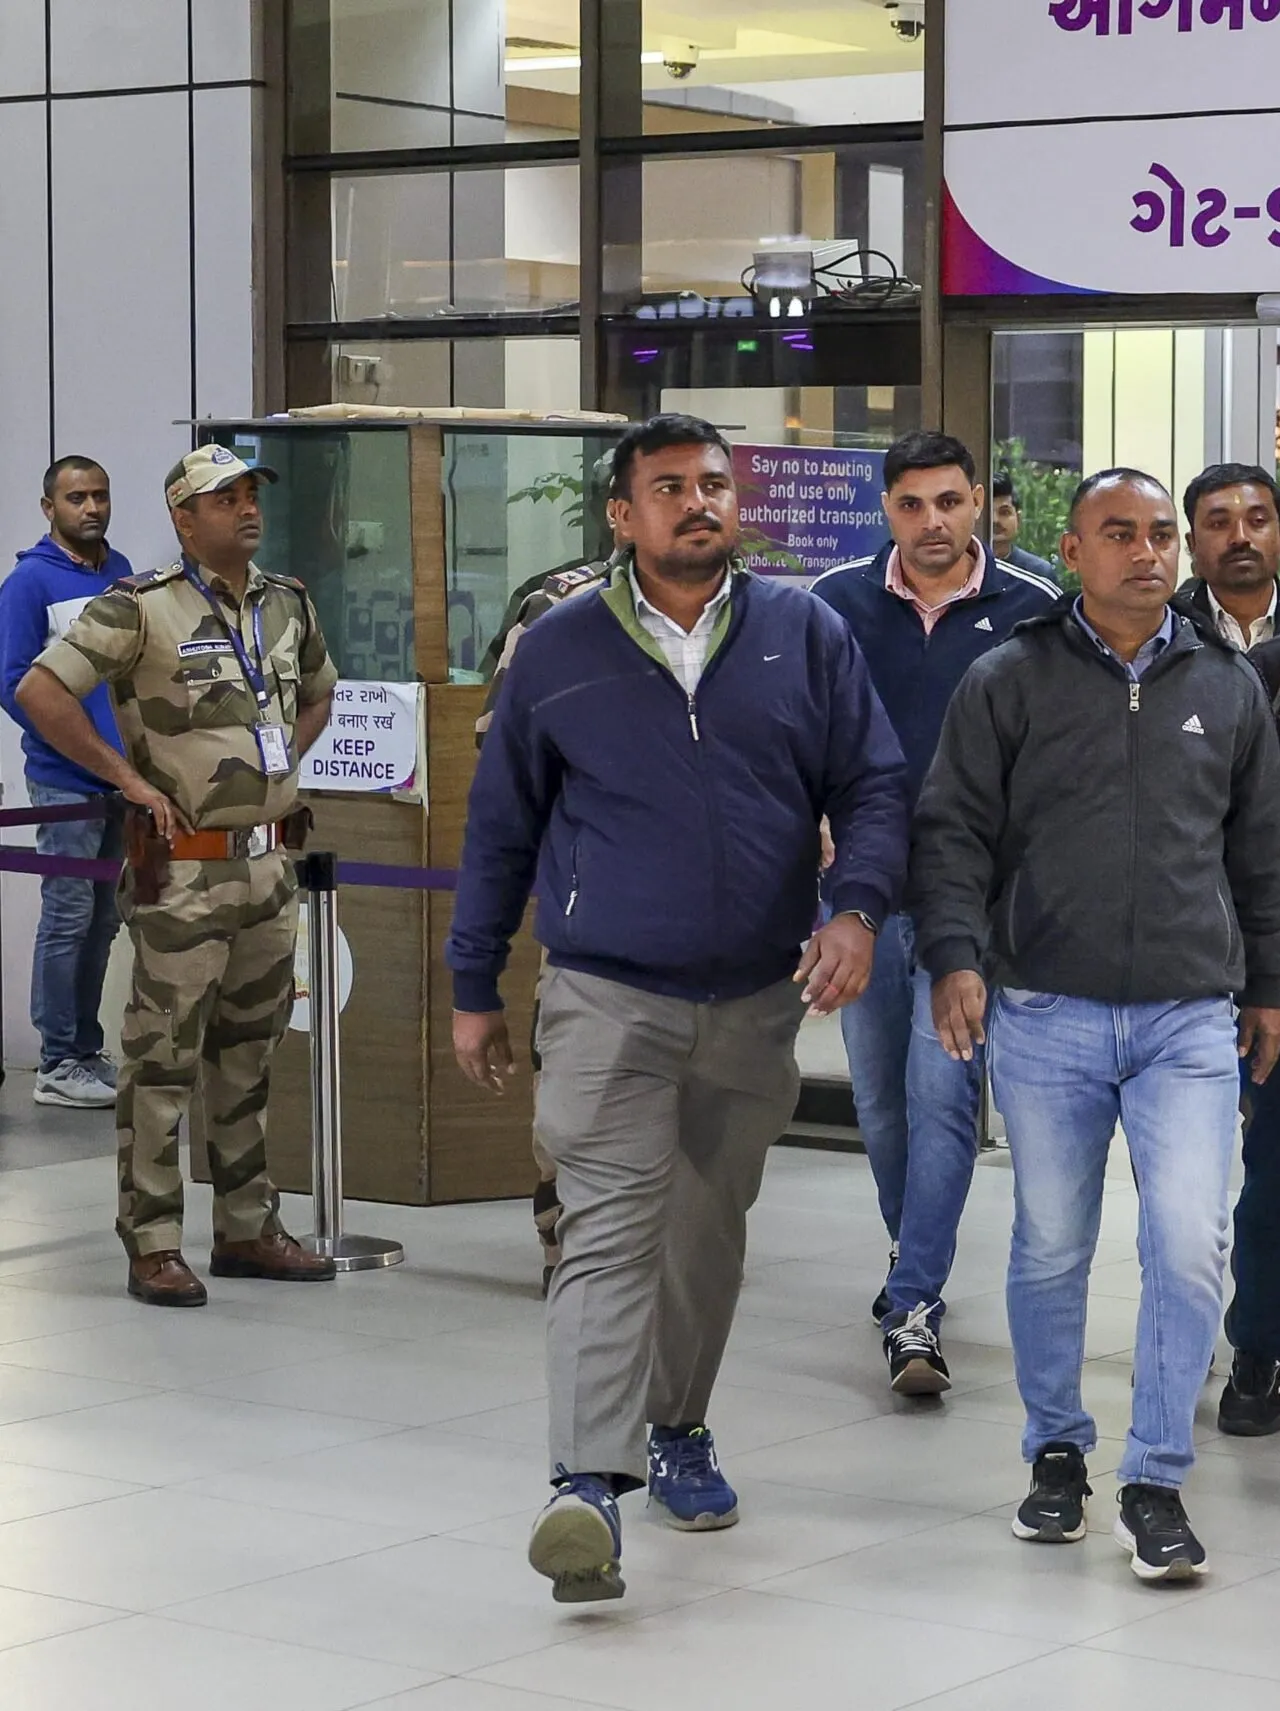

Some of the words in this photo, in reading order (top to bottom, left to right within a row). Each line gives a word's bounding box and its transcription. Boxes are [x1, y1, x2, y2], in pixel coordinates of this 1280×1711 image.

[751, 454, 779, 478] Say
[782, 460, 800, 475] no
[804, 458, 819, 476] to
[822, 460, 873, 482] touting
[769, 481, 795, 499] and
[800, 485, 824, 500] use
[827, 483, 857, 505] only
[739, 504, 816, 524] authorized
[820, 507, 884, 530] transport
[787, 533, 814, 548] Book
[816, 534, 839, 550] only
[332, 689, 353, 702] તર
[360, 686, 387, 703] રાખો
[337, 714, 368, 731] बनाए
[372, 711, 396, 730] रखें
[333, 738, 375, 756] KEEP
[313, 759, 395, 780] DISTANCE
